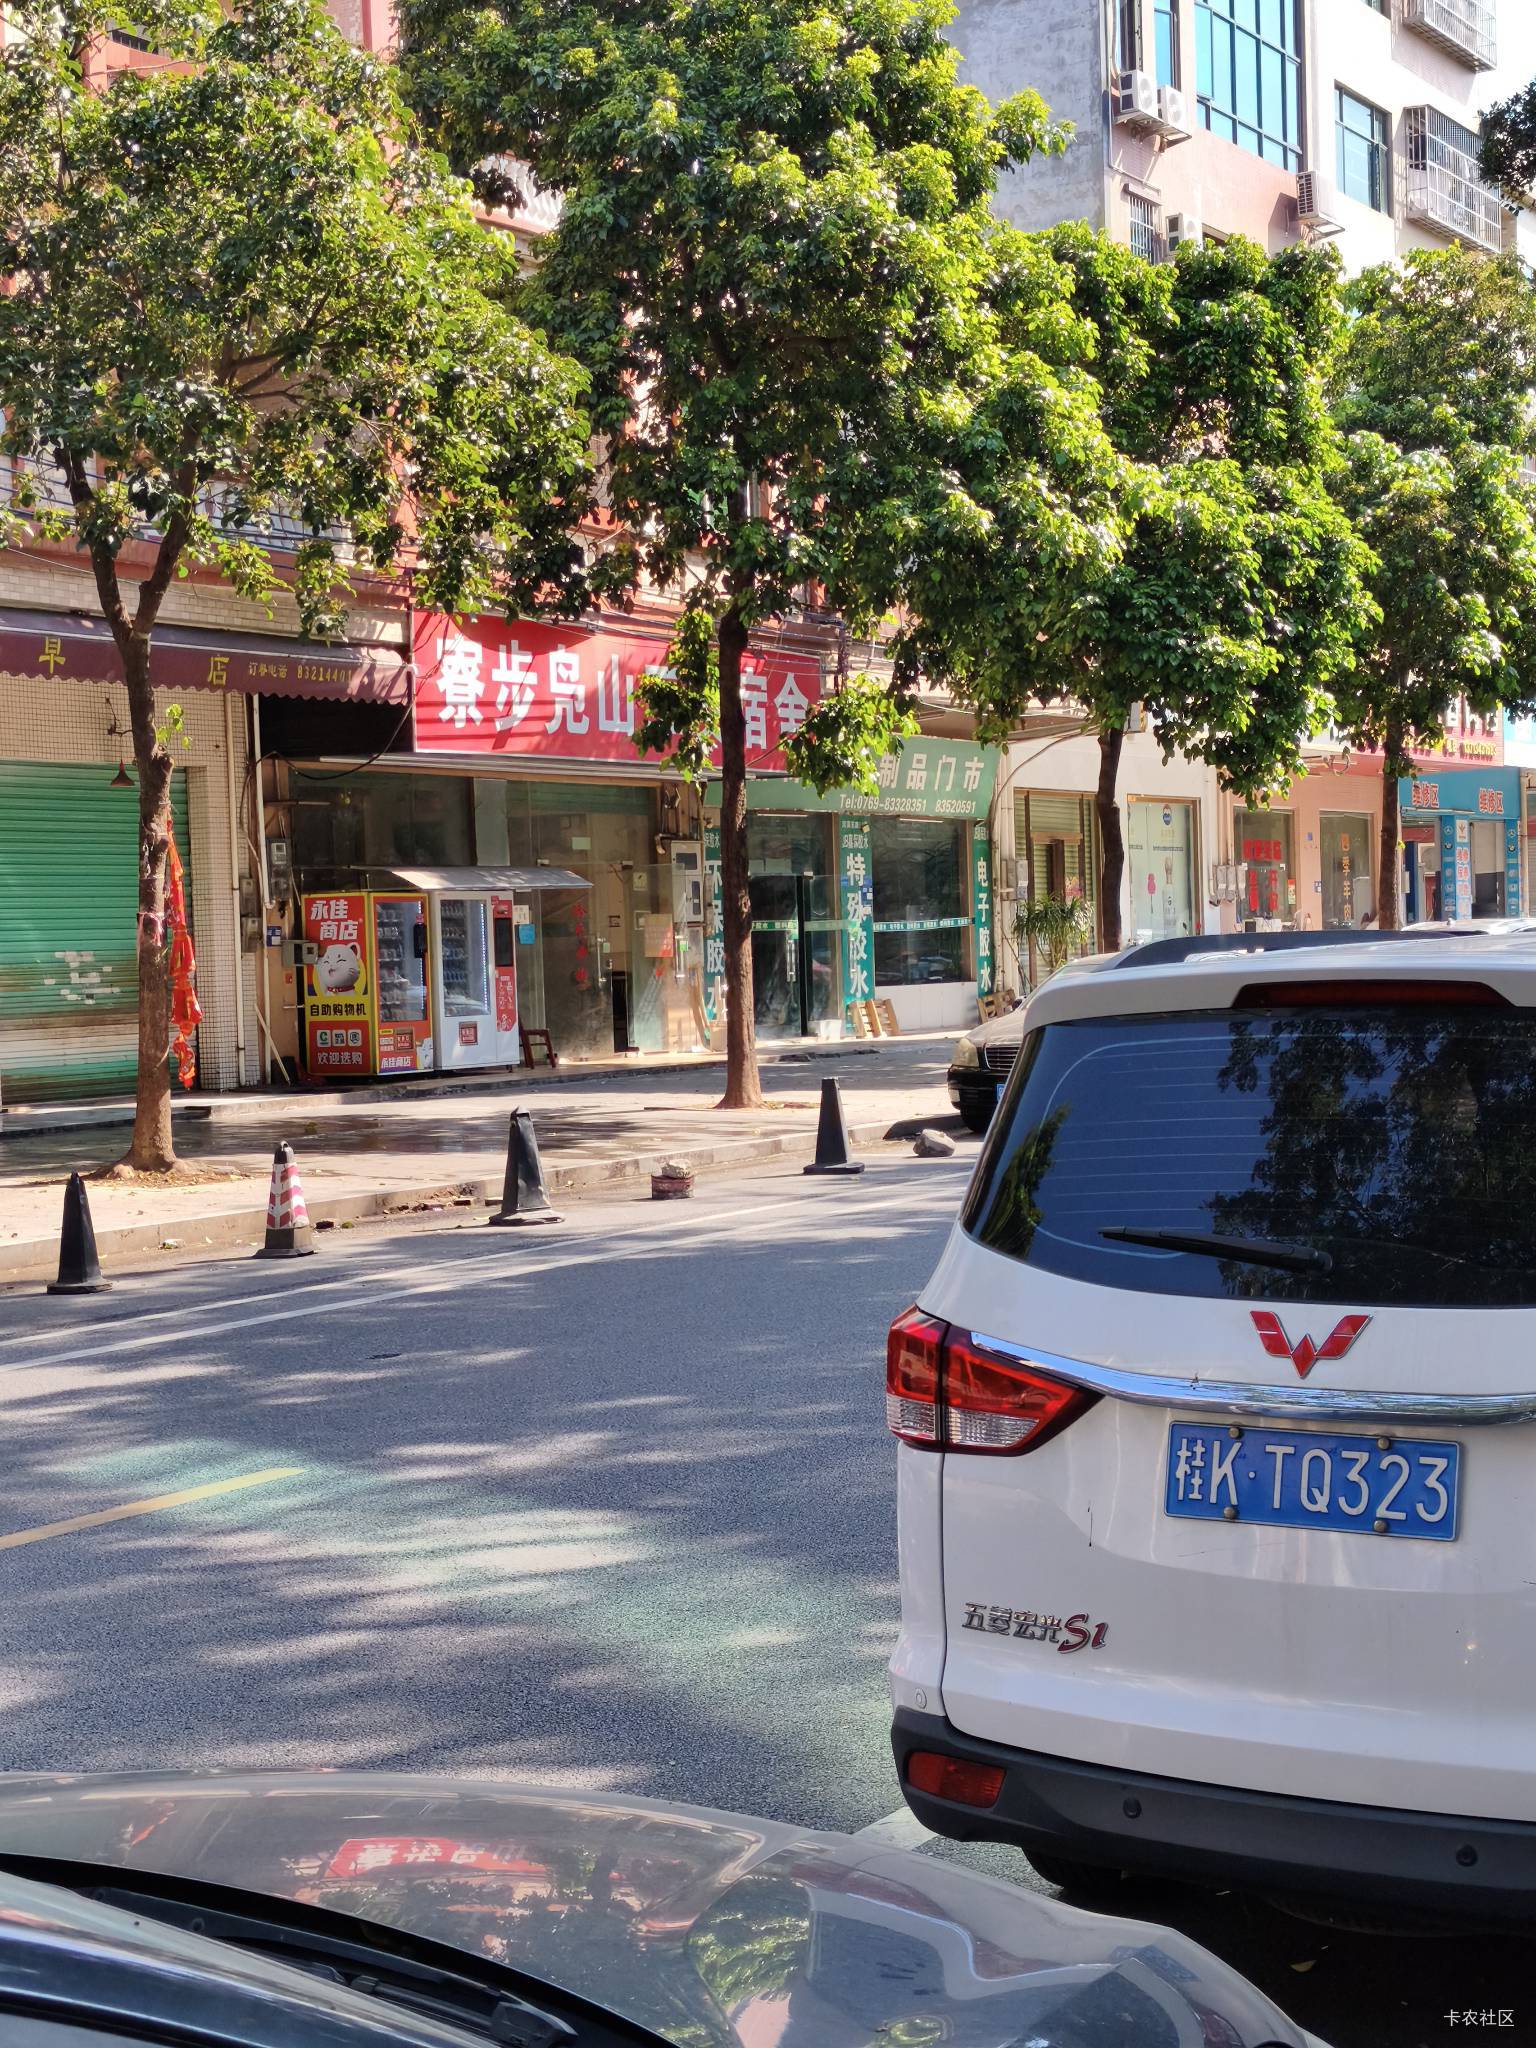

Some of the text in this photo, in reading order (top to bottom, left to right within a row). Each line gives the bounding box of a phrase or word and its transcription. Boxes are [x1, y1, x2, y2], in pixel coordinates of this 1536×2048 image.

[436, 633, 808, 749] 寮步凫山宿舍
[1479, 786, 1504, 815] 维修区
[310, 899, 349, 920] 永佳
[319, 921, 359, 941] 商店
[977, 857, 992, 993] 电子胶水
[310, 1003, 367, 1017] 自助购物机
[317, 1051, 363, 1066] 欢迎选购
